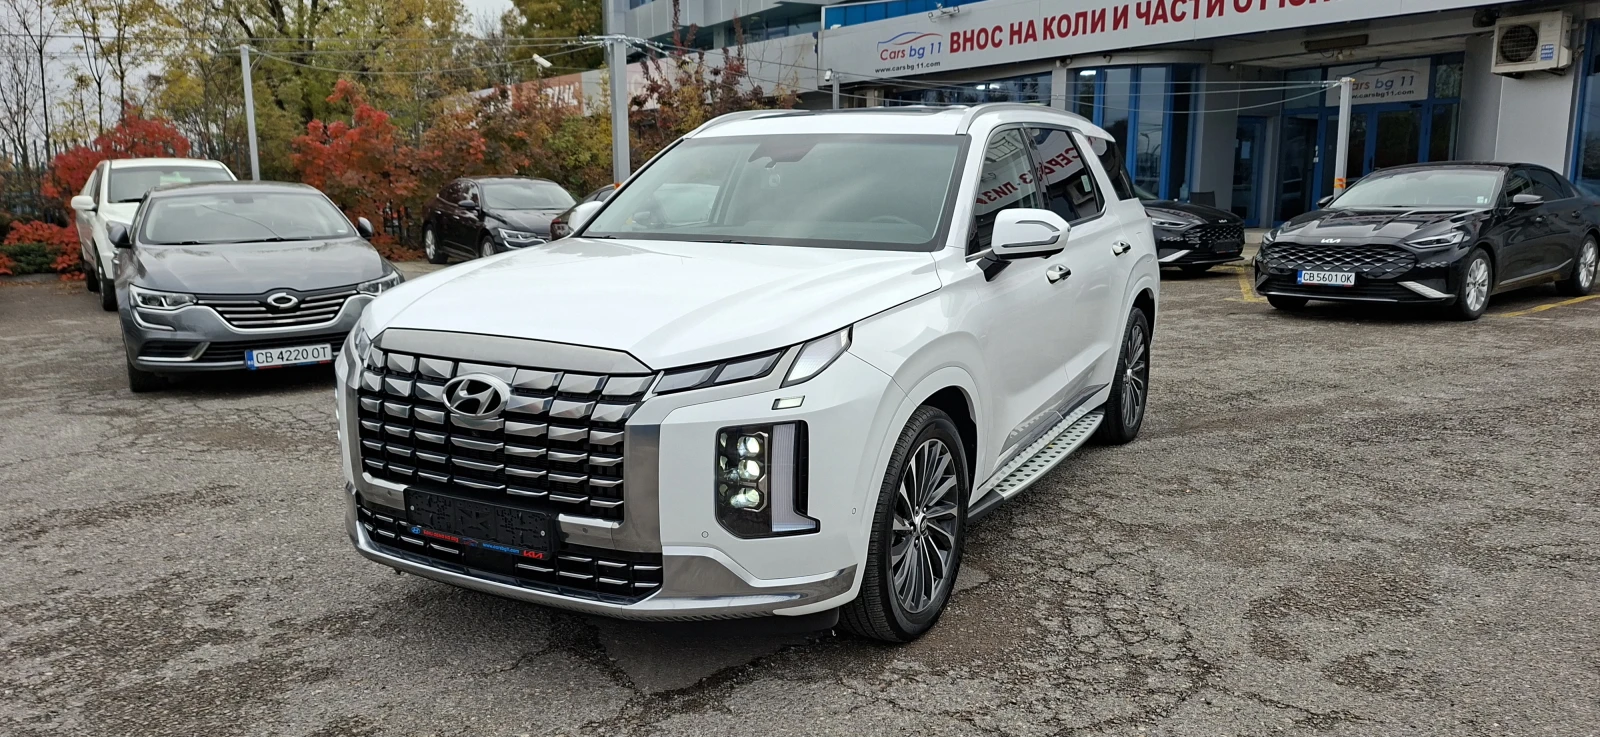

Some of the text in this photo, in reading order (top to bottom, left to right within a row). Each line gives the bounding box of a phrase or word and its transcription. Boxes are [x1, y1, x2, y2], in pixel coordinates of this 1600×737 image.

[950, 25, 1003, 54] ВНОС
[1009, 19, 1038, 46] НА
[1042, 7, 1107, 41] КОЛИ
[1112, 4, 1129, 31] И
[1136, 0, 1225, 26] ЧАСТИ
[880, 42, 942, 61] Cars bg 11
[1374, 78, 1394, 91] bg
[1401, 75, 1415, 87] 11
[1303, 272, 1353, 284] CB 5601 OK
[256, 351, 274, 364] CB
[277, 348, 309, 362] 4220
[311, 346, 328, 359] OT
